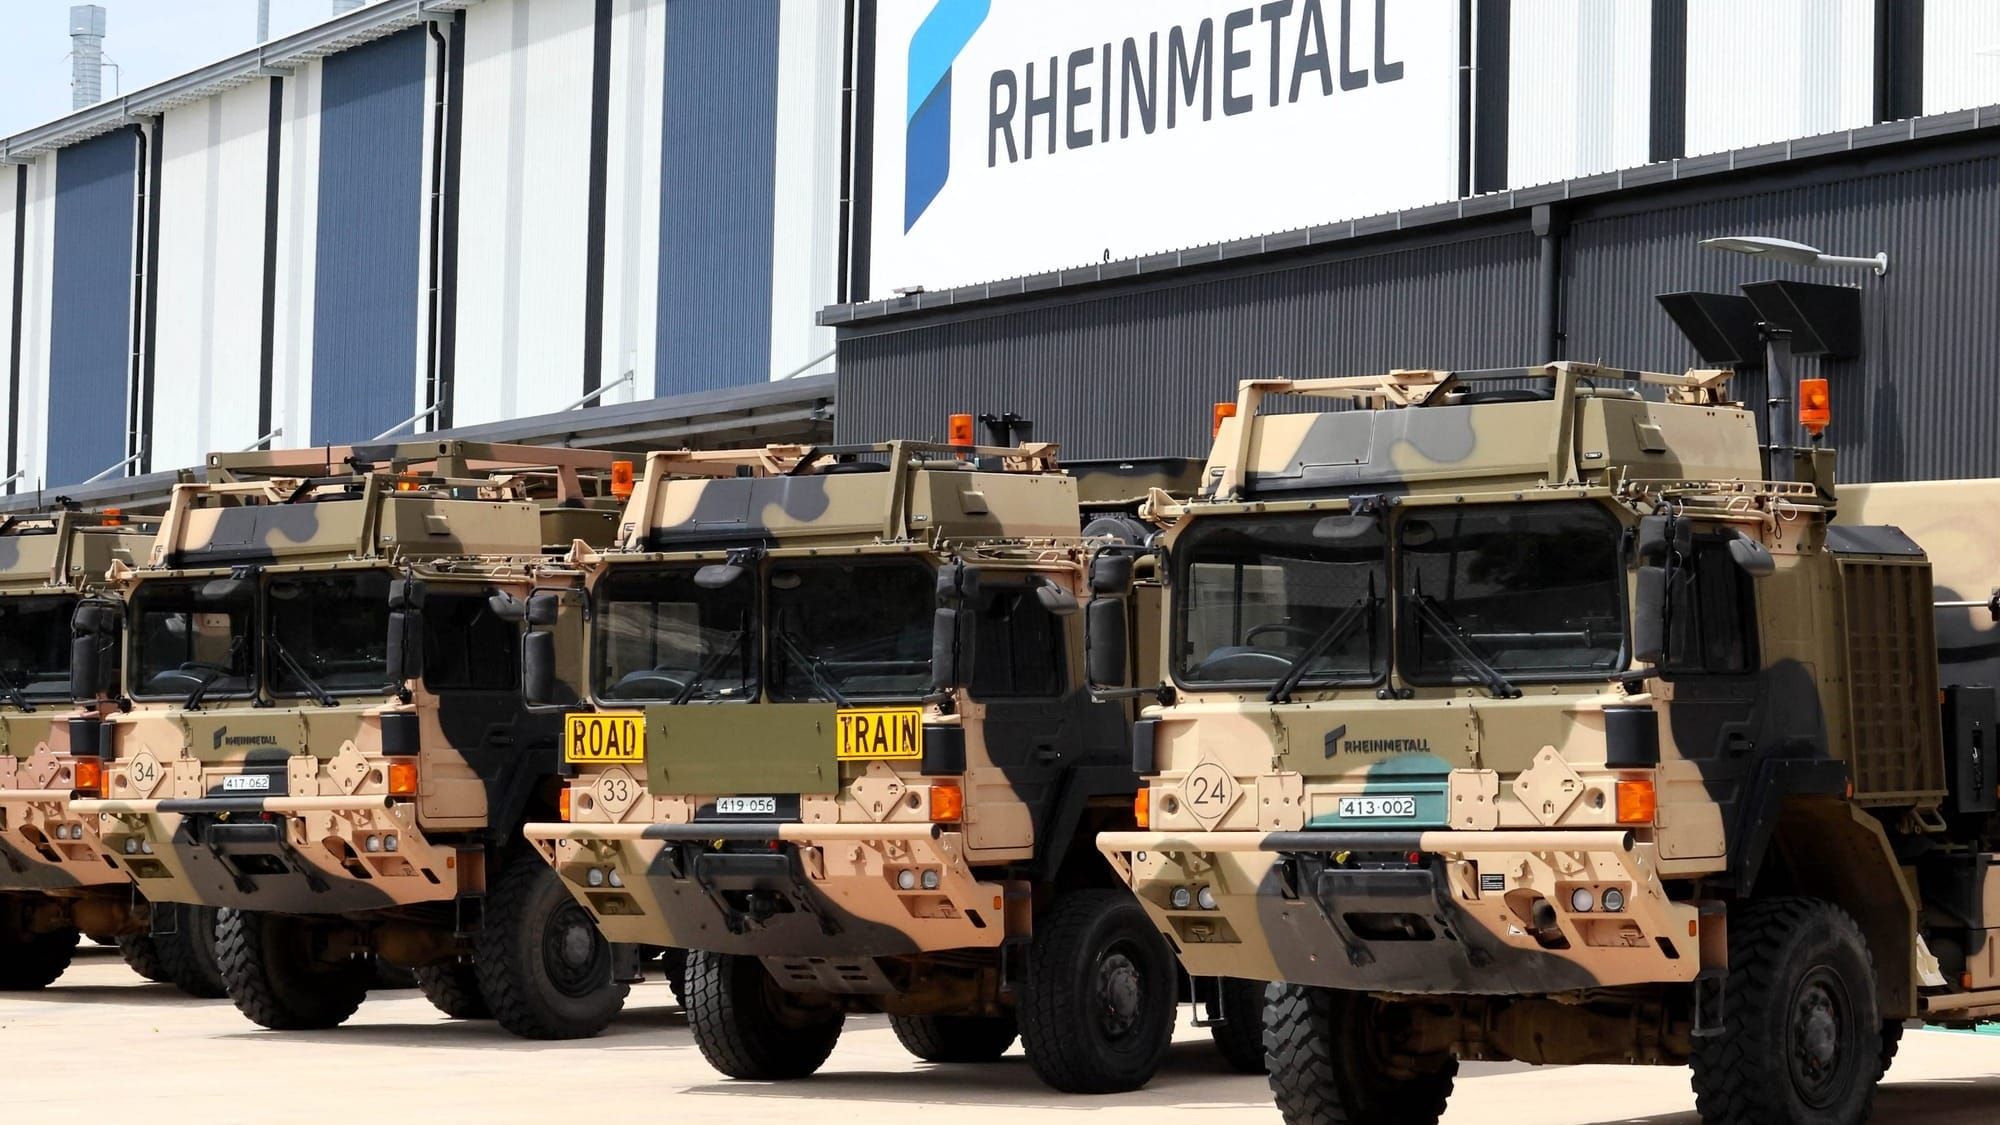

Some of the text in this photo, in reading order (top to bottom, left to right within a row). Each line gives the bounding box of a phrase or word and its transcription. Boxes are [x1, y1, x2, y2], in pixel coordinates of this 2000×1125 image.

[988, 0, 1404, 168] RHEINMETALL
[225, 735, 277, 746] RHEINMETALL
[573, 713, 917, 758] ROAD TRAIN
[1344, 739, 1431, 754] RHEINMETALL
[134, 761, 155, 782] 34
[603, 779, 628, 802] 33
[1193, 776, 1226, 805] 24
